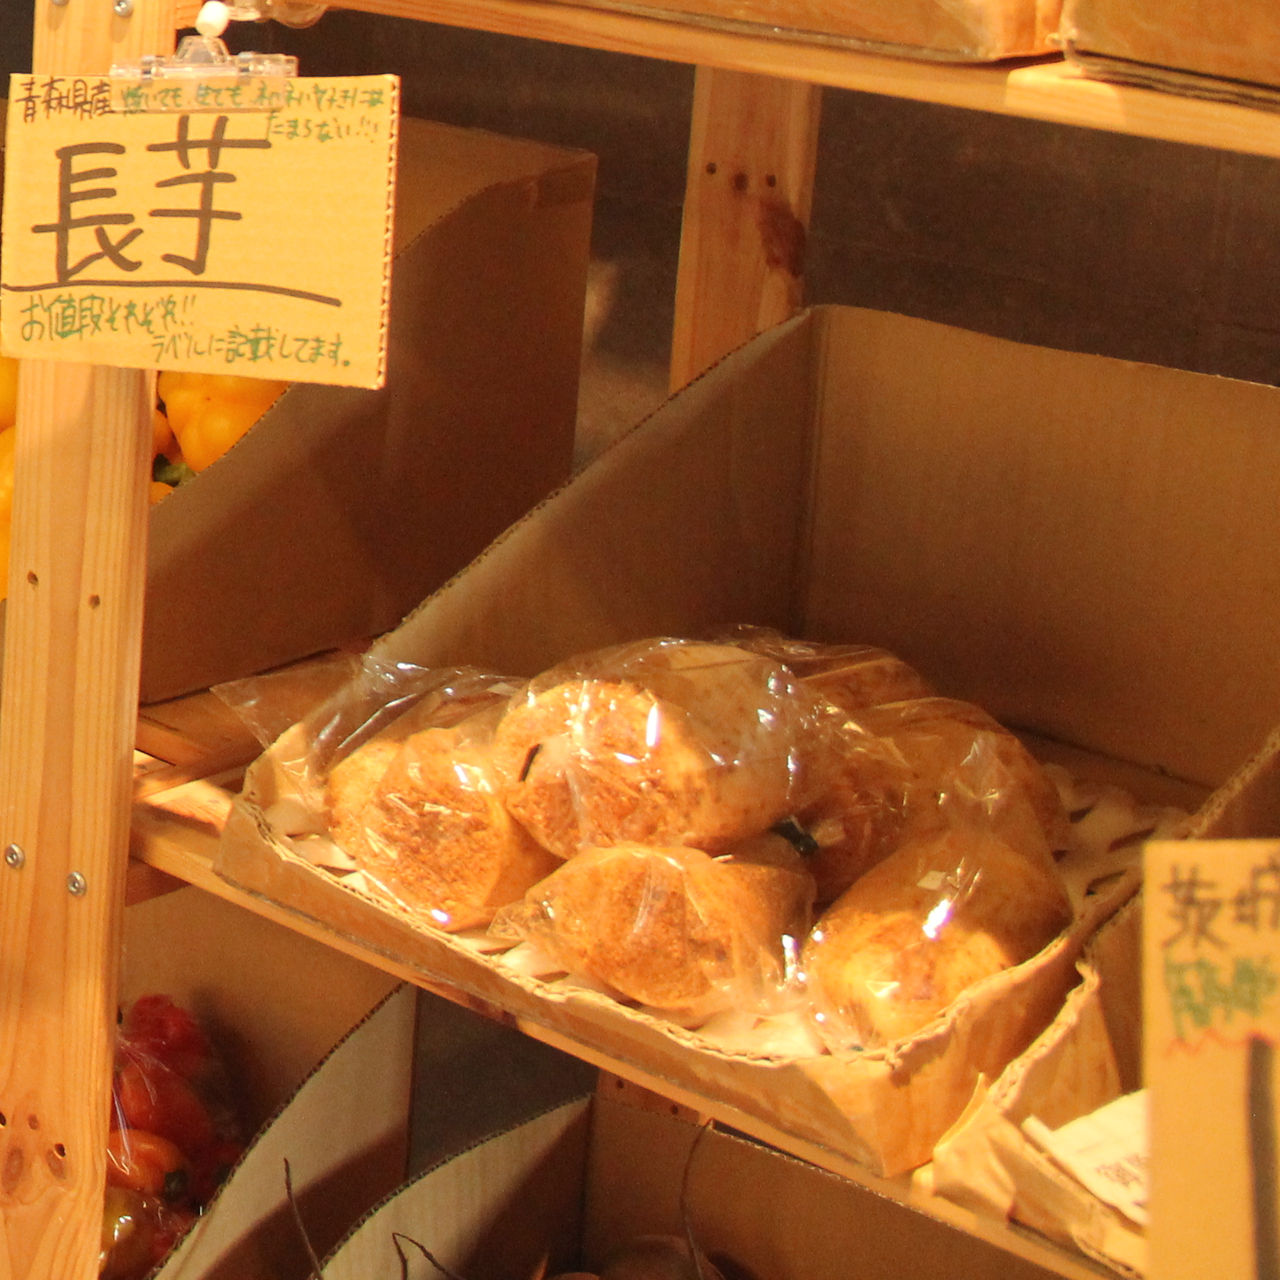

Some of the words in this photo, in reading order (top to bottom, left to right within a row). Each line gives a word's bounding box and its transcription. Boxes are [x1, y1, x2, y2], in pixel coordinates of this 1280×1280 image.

[14, 76, 113, 123] 青森県産
[31, 114, 273, 283] 長芋
